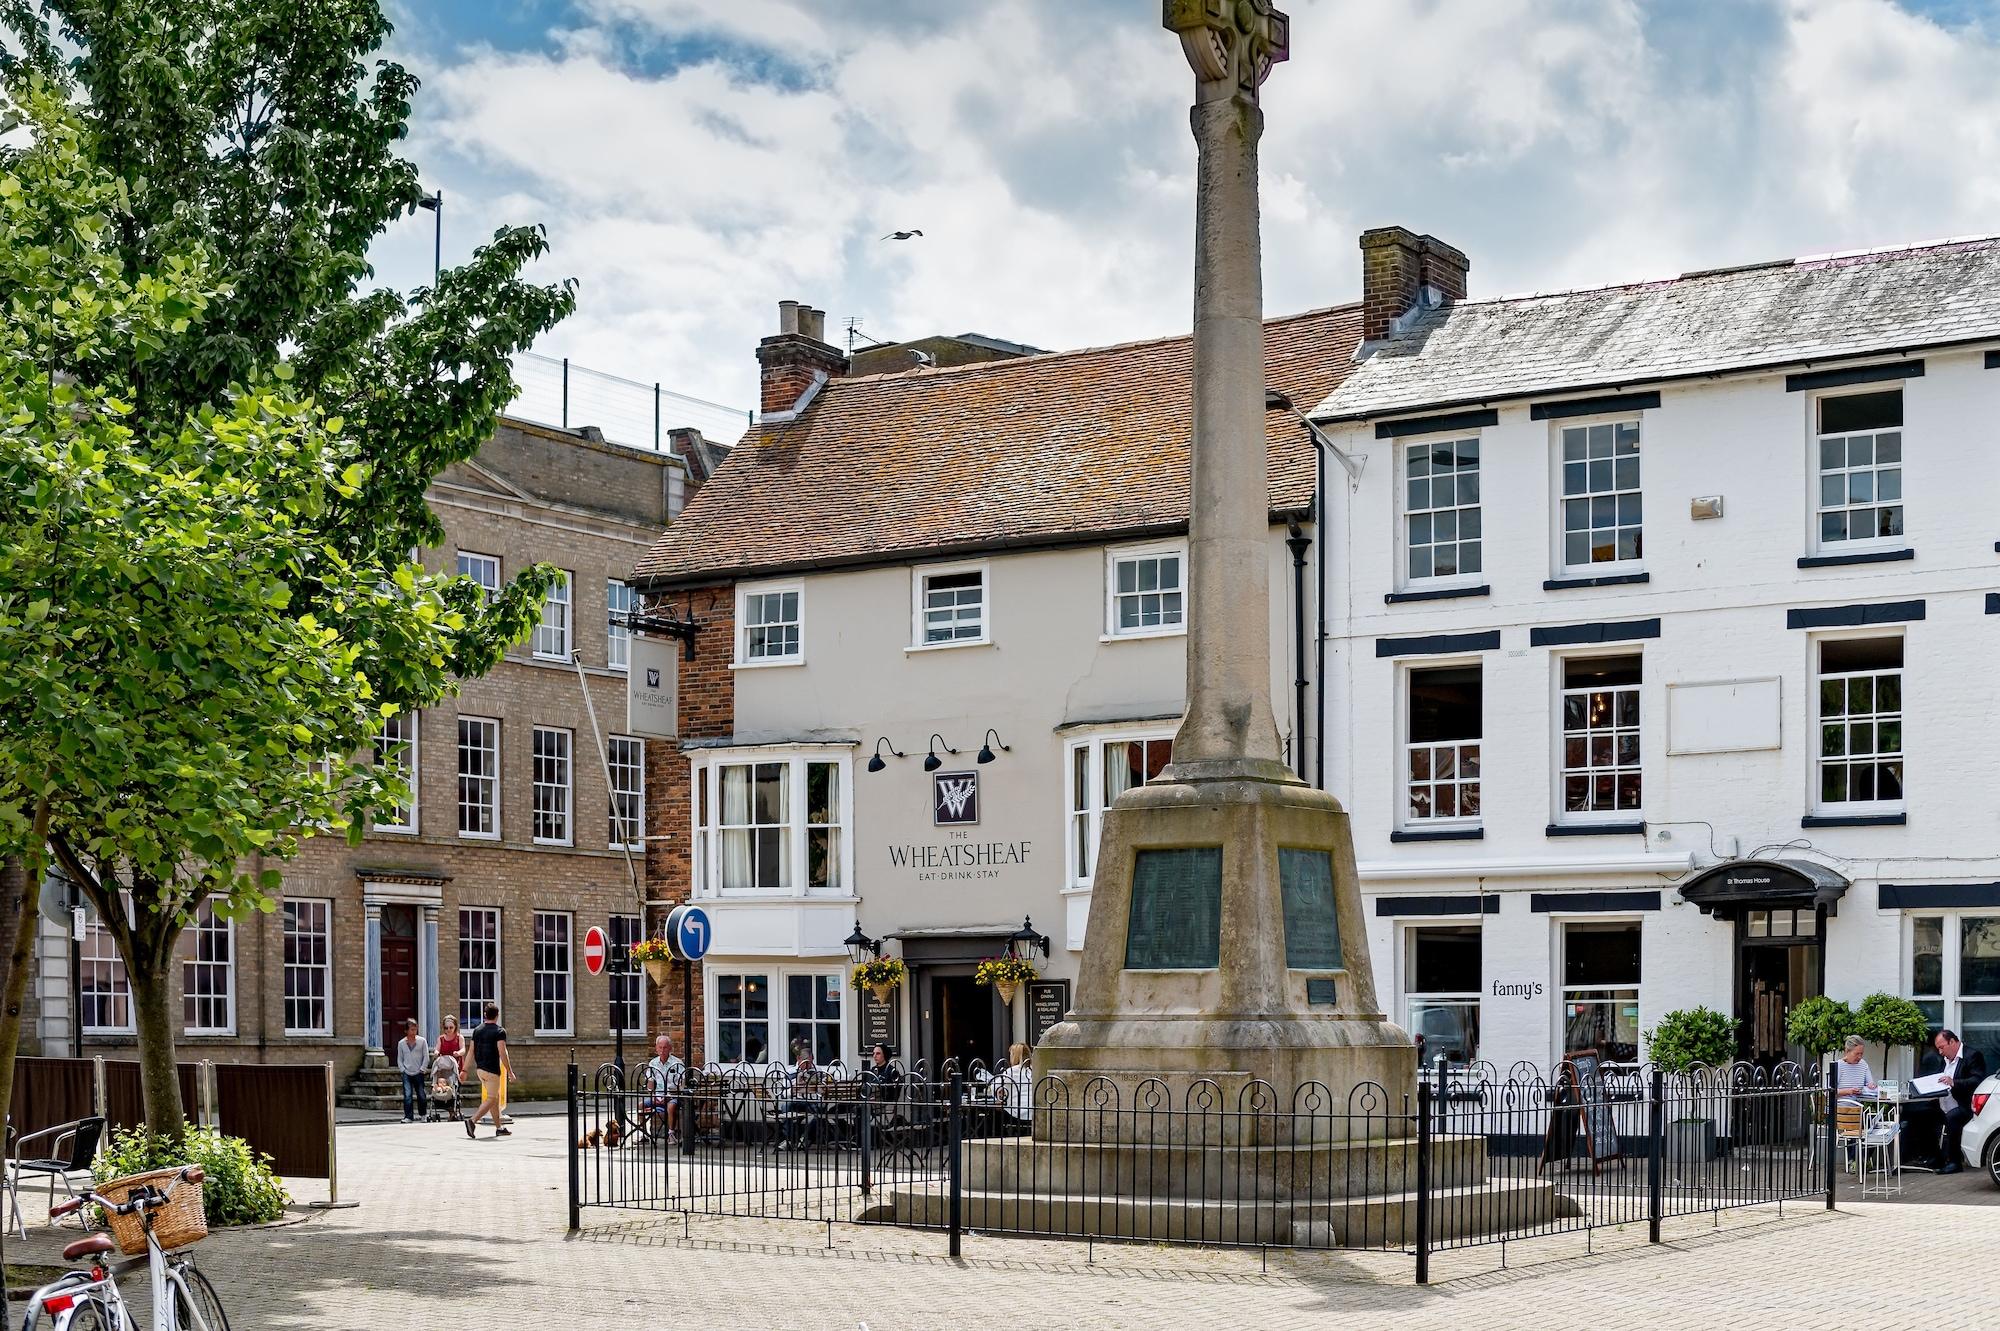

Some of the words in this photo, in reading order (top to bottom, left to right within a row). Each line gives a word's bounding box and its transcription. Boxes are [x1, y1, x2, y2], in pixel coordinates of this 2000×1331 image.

[633, 690, 672, 704] WHEATSHEAF
[949, 831, 968, 839] THE
[888, 841, 1032, 868] WHEATSHEAF
[1492, 980, 1543, 1000] fanny's
